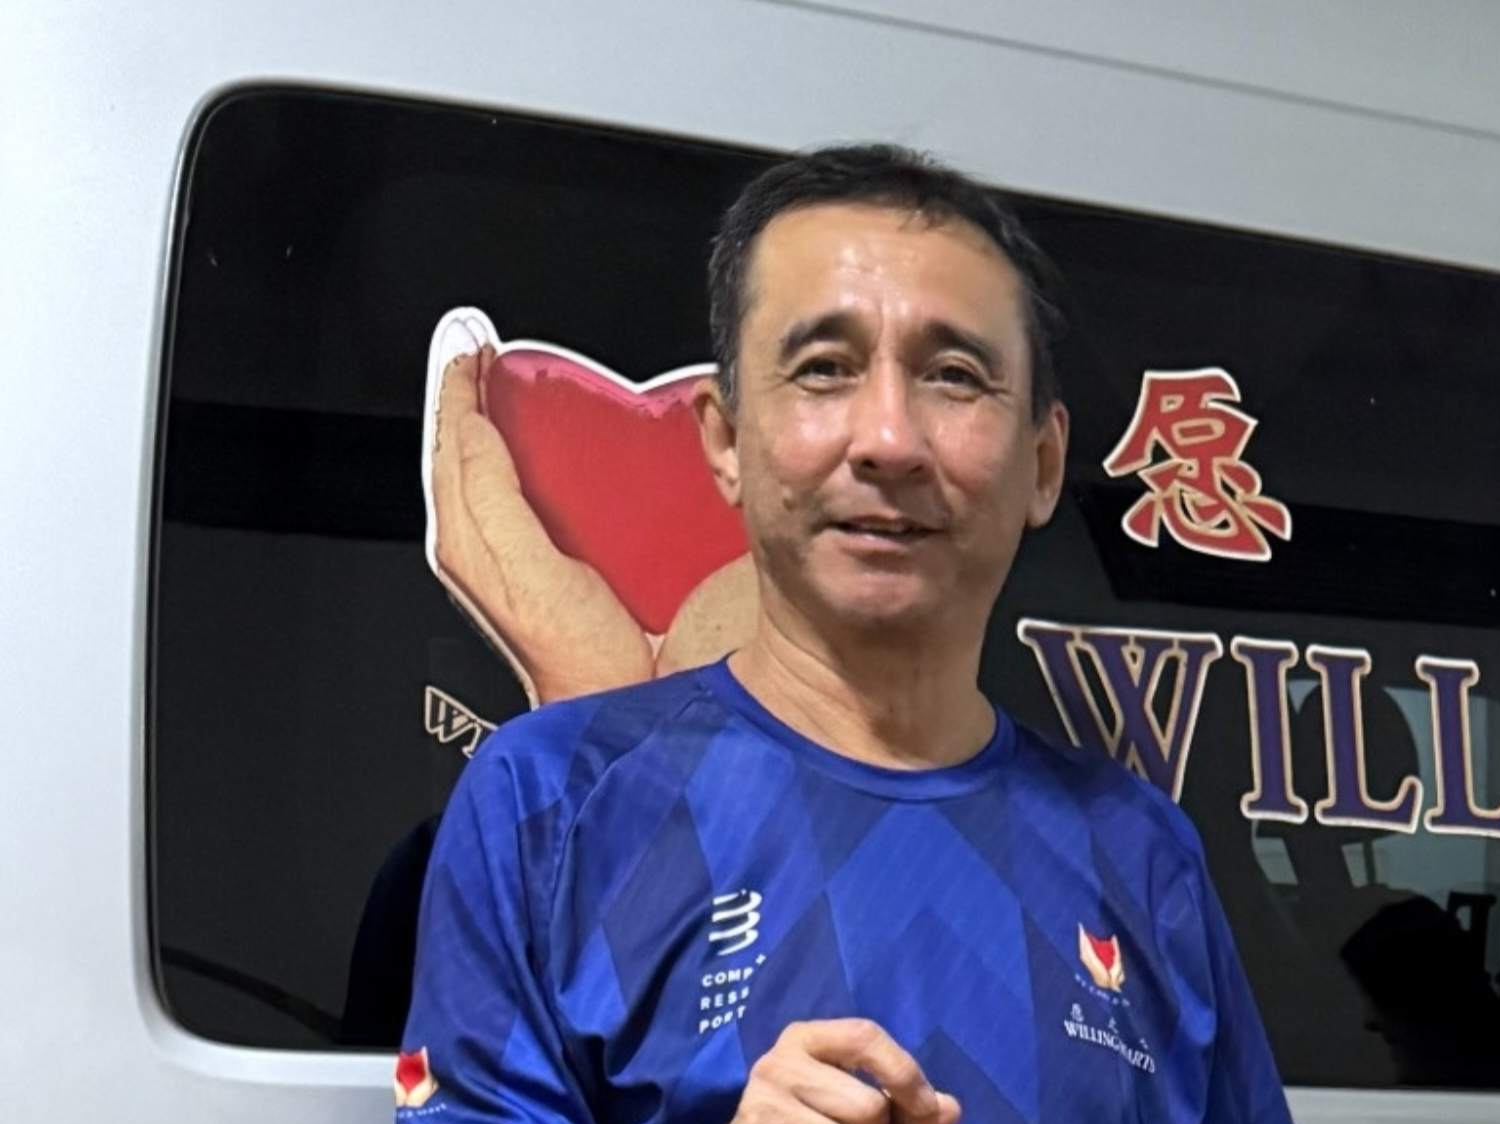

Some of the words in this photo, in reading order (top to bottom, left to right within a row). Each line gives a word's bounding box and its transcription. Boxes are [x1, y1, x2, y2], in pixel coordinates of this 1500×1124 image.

[1103, 367, 1292, 562] 愿
[702, 966, 753, 988] COMP
[699, 1005, 746, 1034] PORT
